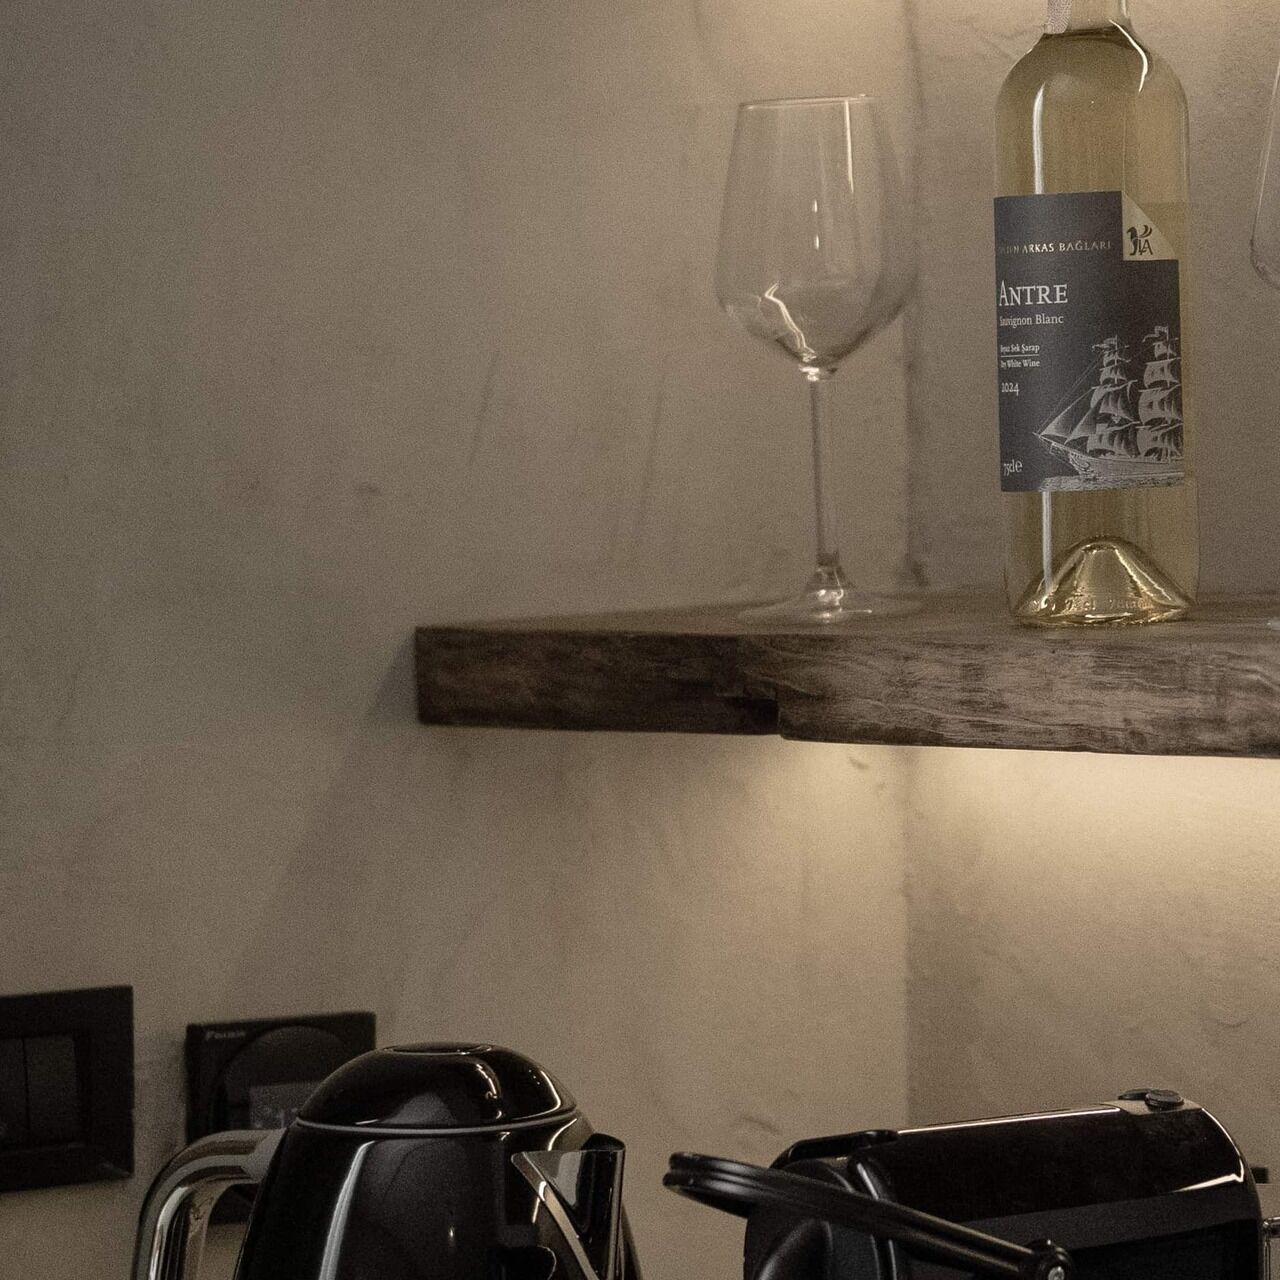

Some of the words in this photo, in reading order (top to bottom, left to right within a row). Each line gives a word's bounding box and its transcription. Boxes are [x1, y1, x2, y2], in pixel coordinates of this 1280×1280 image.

[1022, 242, 1055, 255] ARKAS
[999, 279, 1069, 307] ANTRE
[1035, 312, 1065, 325] Blanc
